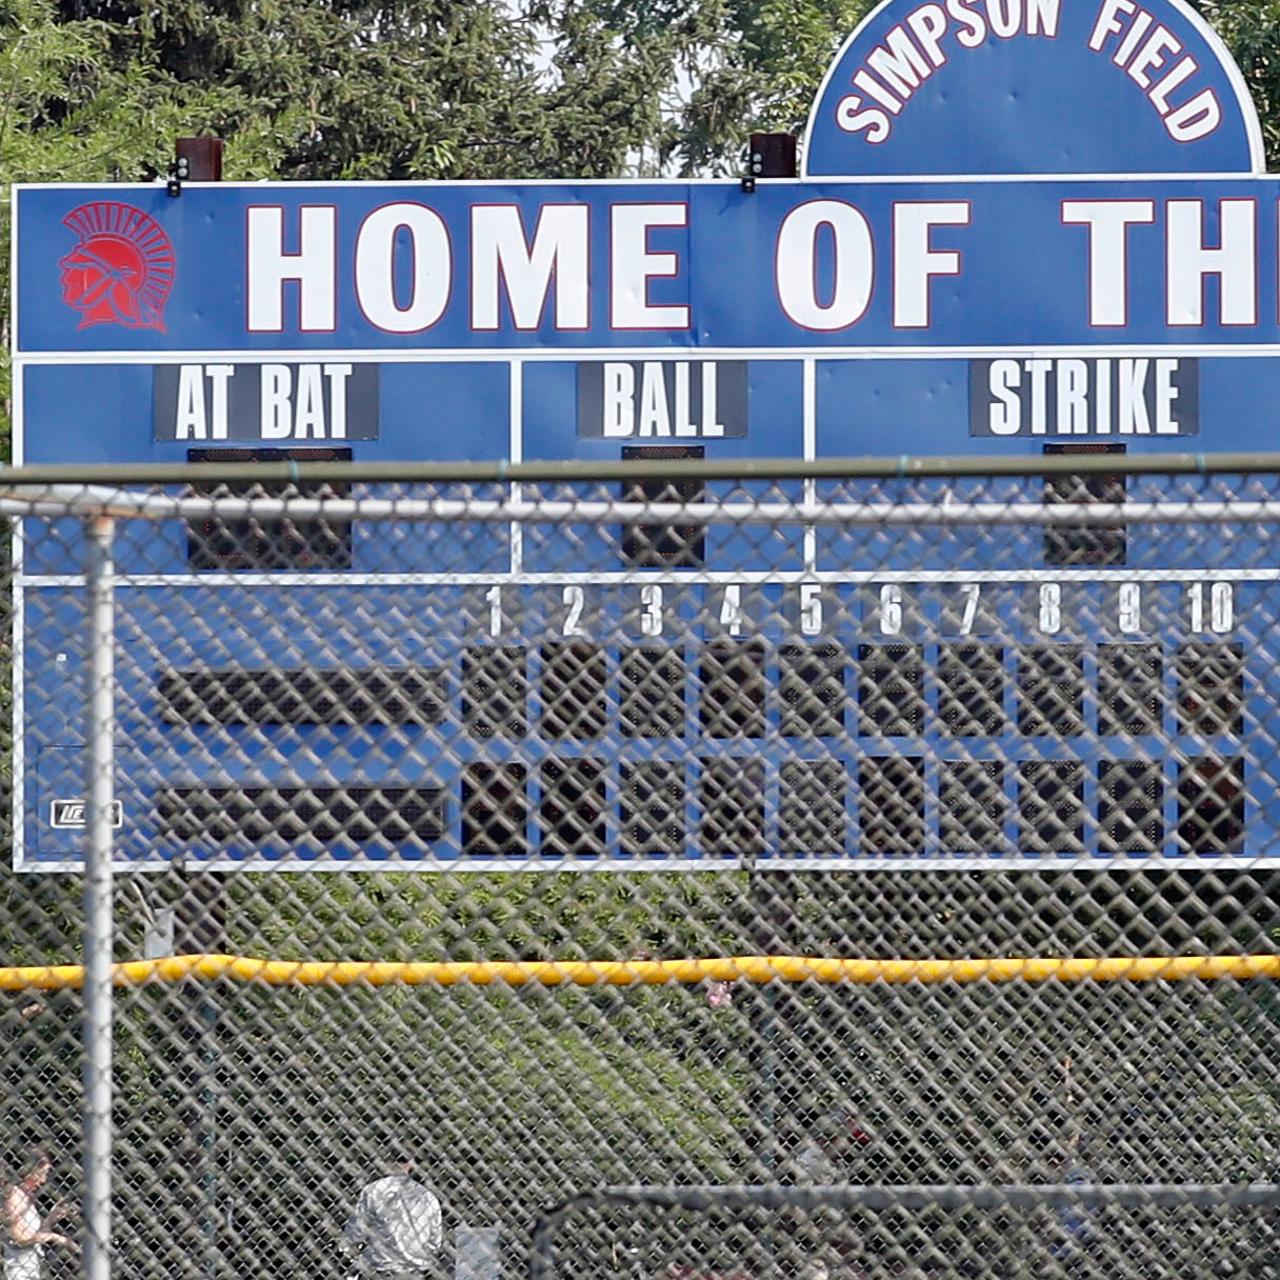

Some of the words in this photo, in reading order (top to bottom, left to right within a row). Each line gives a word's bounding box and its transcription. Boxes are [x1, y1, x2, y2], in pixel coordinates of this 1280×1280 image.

[246, 201, 691, 333] HOME
[775, 199, 972, 332] OF
[175, 364, 234, 439] AT
[260, 364, 353, 438] BAT
[603, 361, 724, 437] BALL
[988, 358, 1180, 435] STRIKE
[486, 586, 501, 636] 1
[562, 586, 583, 636] 2
[641, 585, 662, 636] 3
[721, 585, 741, 635] 4
[800, 585, 822, 635] 5
[880, 584, 902, 635] 6
[960, 584, 979, 634] 7
[1039, 583, 1061, 633] 8
[1120, 583, 1140, 632] 9
[1187, 583, 1232, 632] 10
